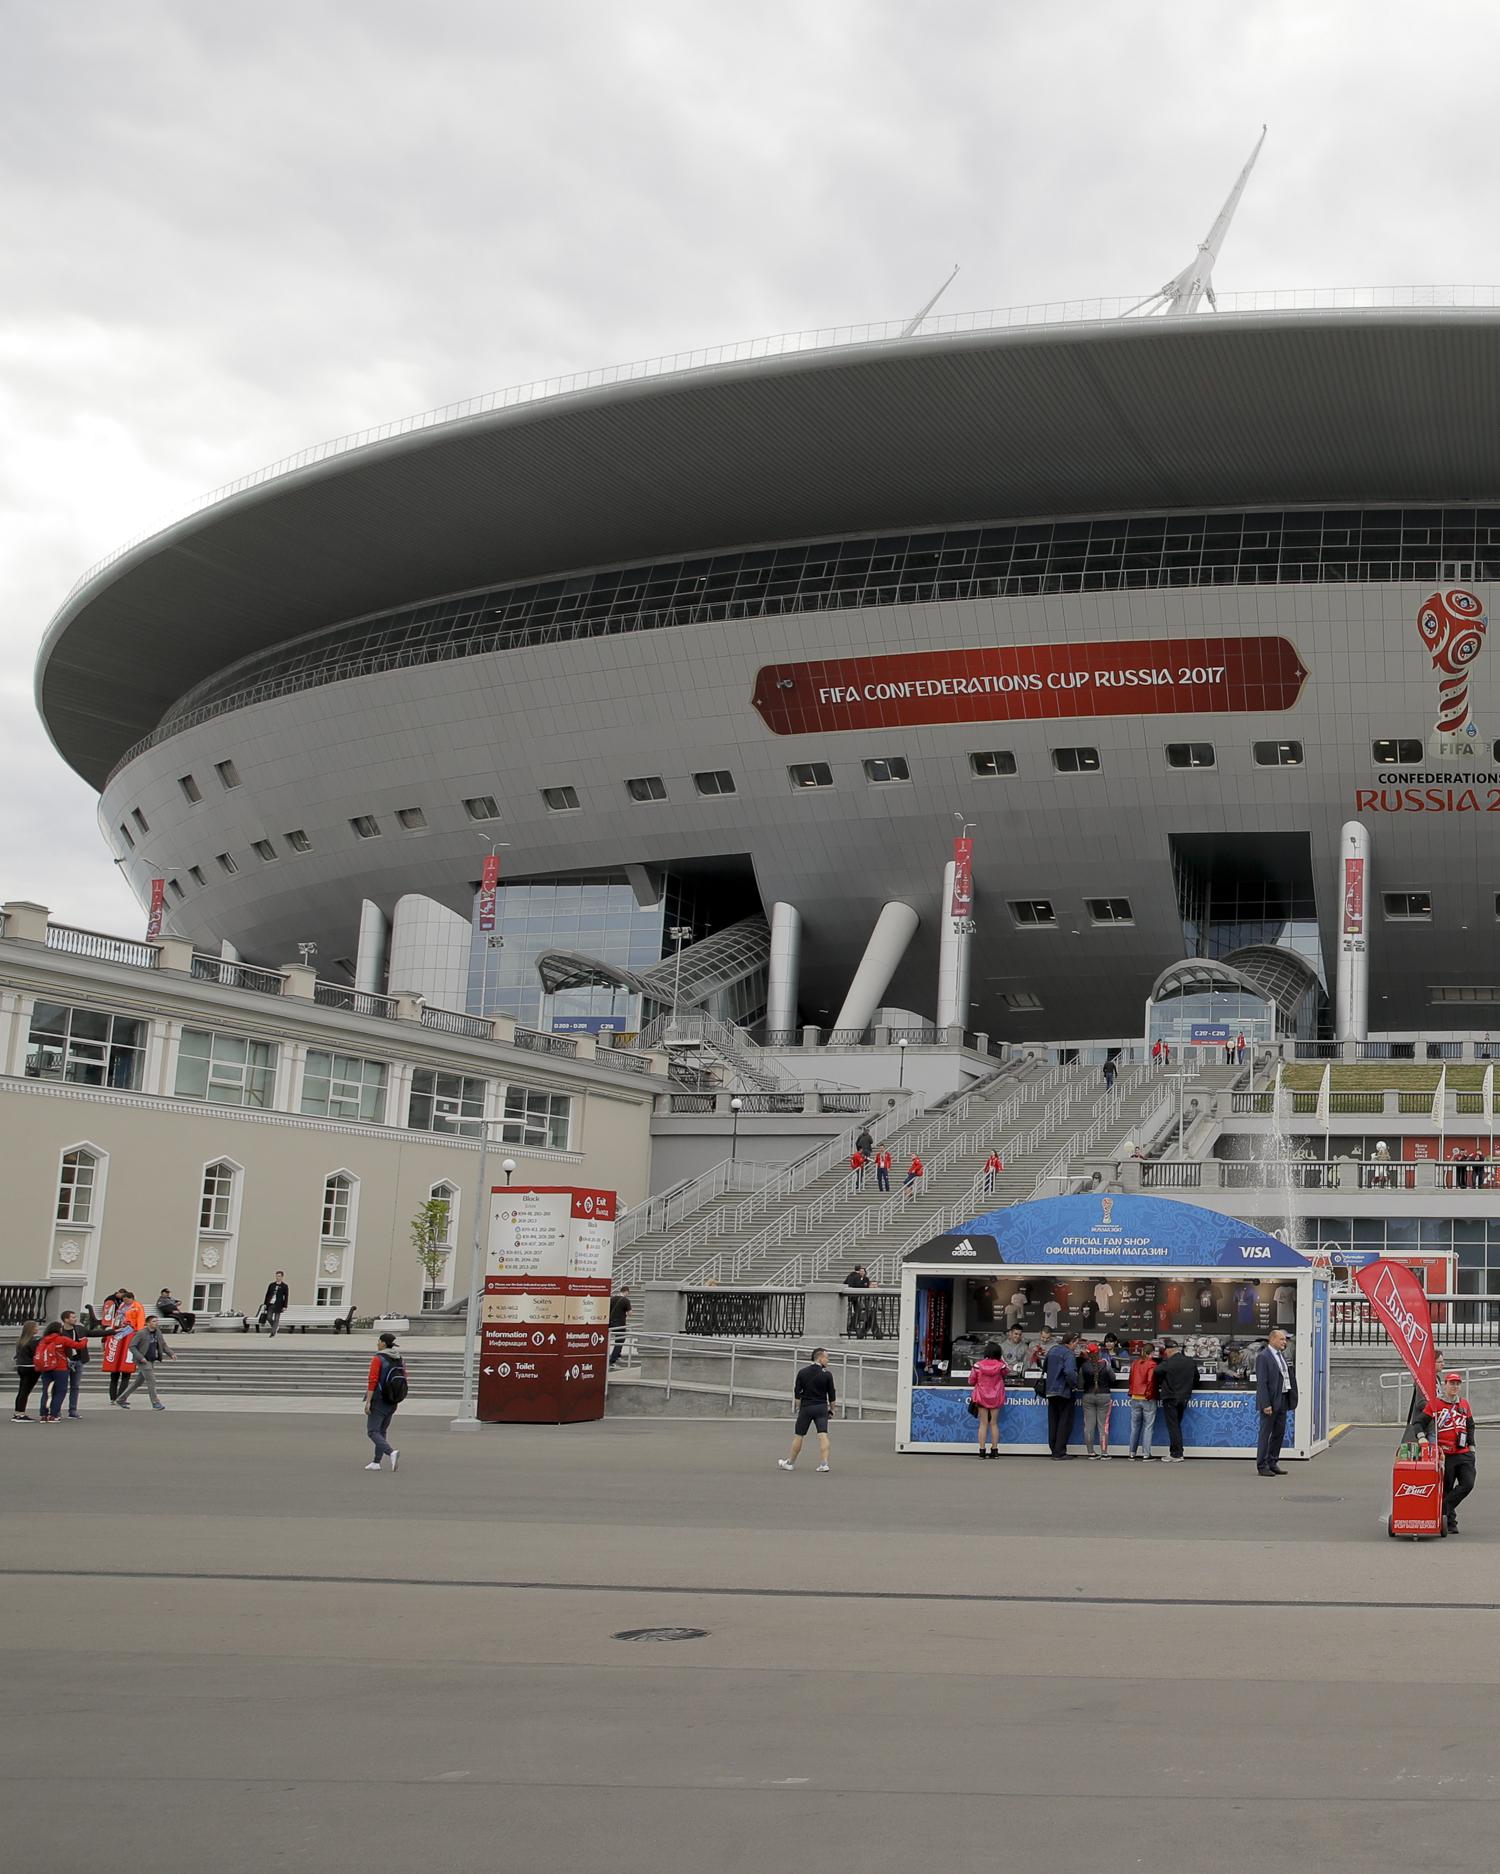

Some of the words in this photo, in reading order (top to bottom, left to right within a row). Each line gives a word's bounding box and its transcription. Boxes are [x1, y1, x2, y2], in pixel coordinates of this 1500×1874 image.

[819, 686, 861, 704] FIFA
[864, 674, 1043, 701] CONFEDERATIONS
[1047, 671, 1090, 689] CUP
[1094, 668, 1174, 687] RUSSIA
[1178, 666, 1225, 684] 2017
[1440, 743, 1474, 755] FIFA
[1356, 789, 1481, 812] RUSSIA
[1062, 1236, 1102, 1246] OFFICIAL
[1104, 1238, 1121, 1246] FAN
[1124, 1238, 1150, 1246] SHOP
[1046, 1246, 1121, 1256] ОФИЦИАЛЬНЫЙ
[1122, 1247, 1168, 1256] МАГАЗИН
[1238, 1246, 1271, 1258] VISA
[486, 1330, 528, 1338] Information
[515, 1362, 535, 1370] Toilet
[1200, 1400, 1220, 1408] FIFA
[1221, 1400, 1242, 1408] 2017
[1403, 1484, 1428, 1494] Bud
